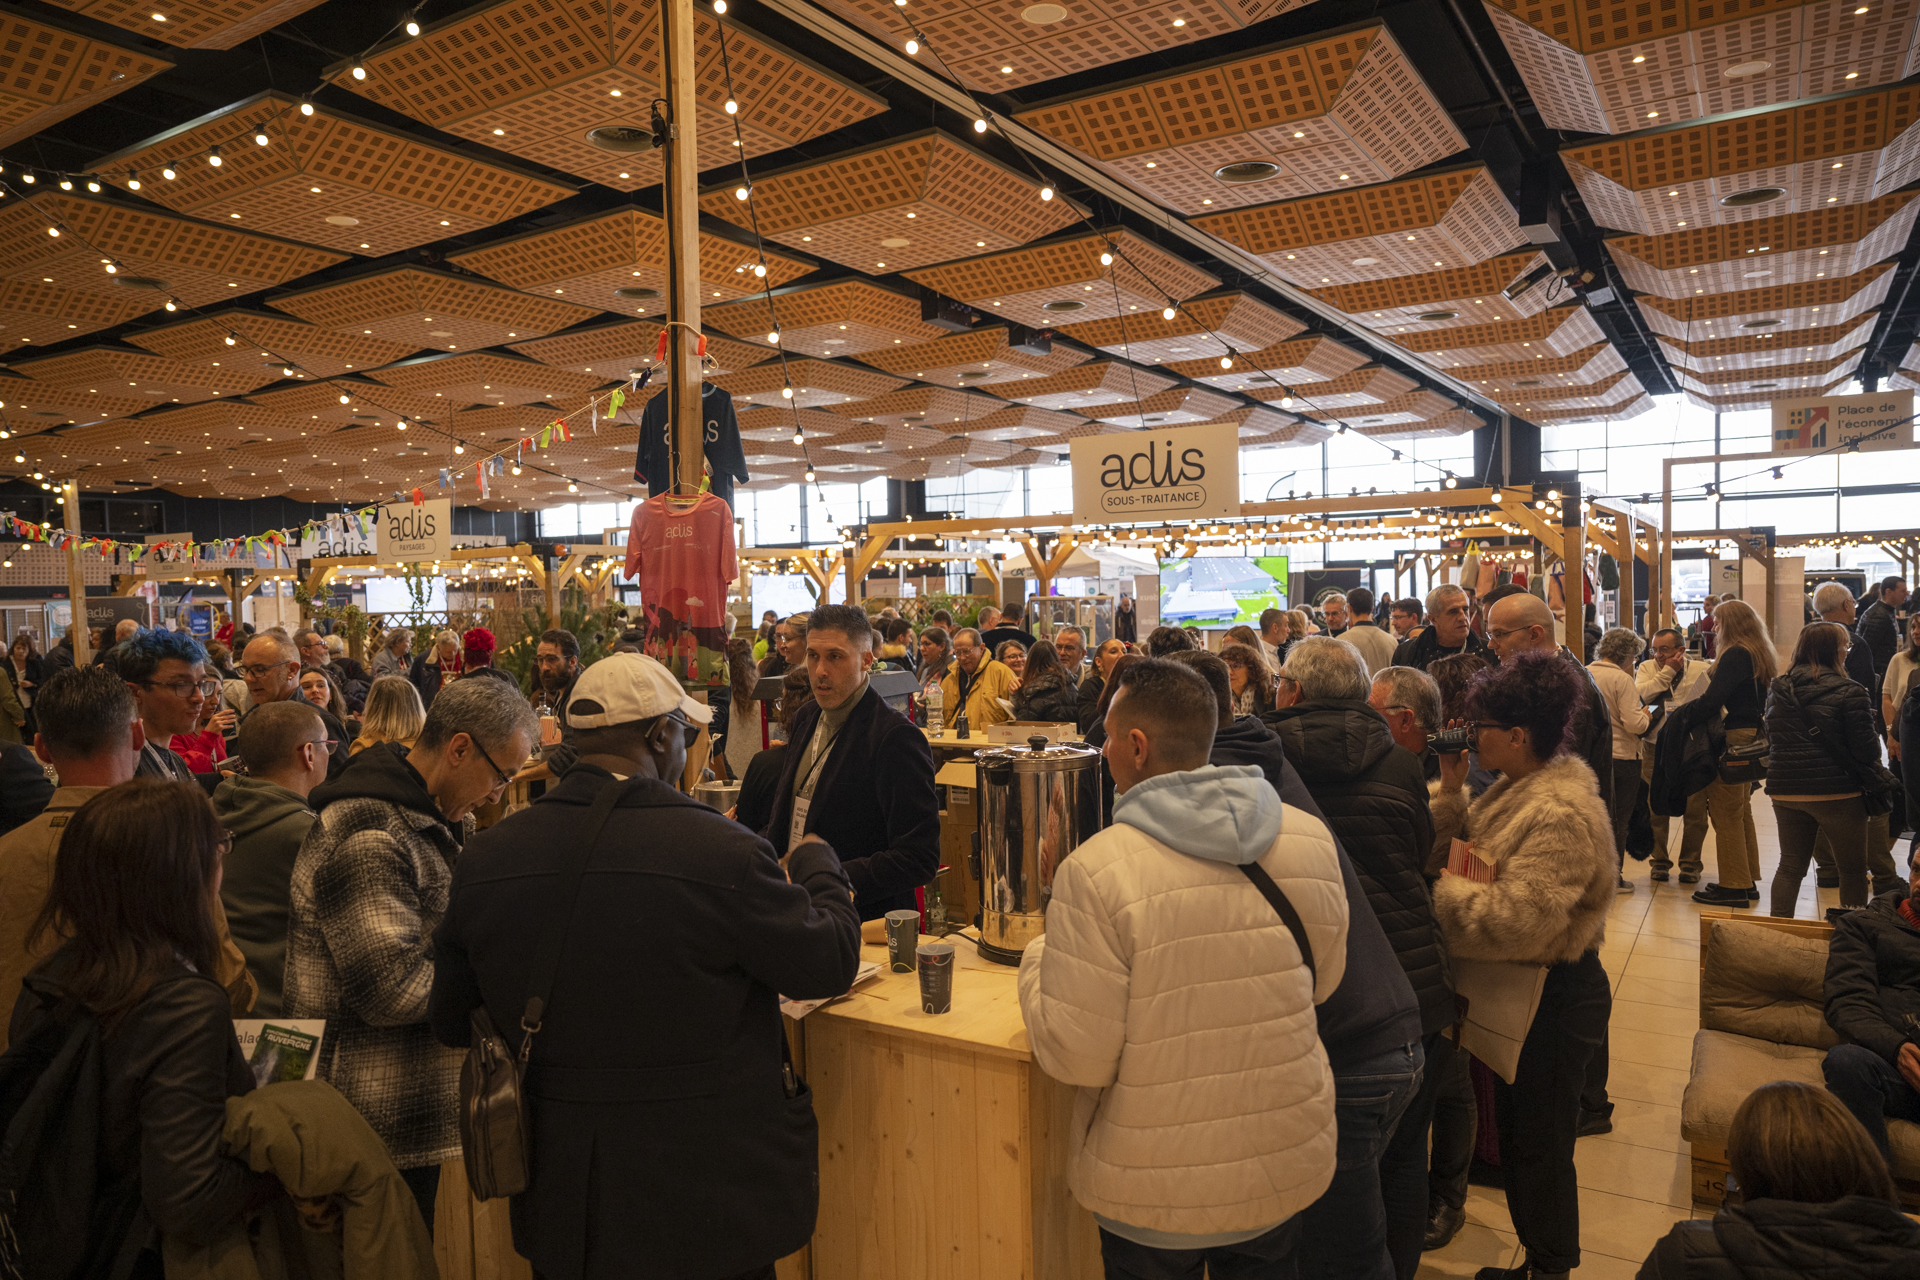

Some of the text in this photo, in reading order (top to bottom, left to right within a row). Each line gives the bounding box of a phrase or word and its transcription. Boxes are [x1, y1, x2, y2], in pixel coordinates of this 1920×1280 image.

[1838, 403, 1896, 416] Place de
[1101, 440, 1206, 491] adis
[1107, 491, 1200, 507] SOUS-TRAITANCE
[389, 509, 436, 542] adis
[666, 524, 694, 540] adis
[399, 543, 426, 552] PAYSAGES
[788, 579, 808, 590] ad
